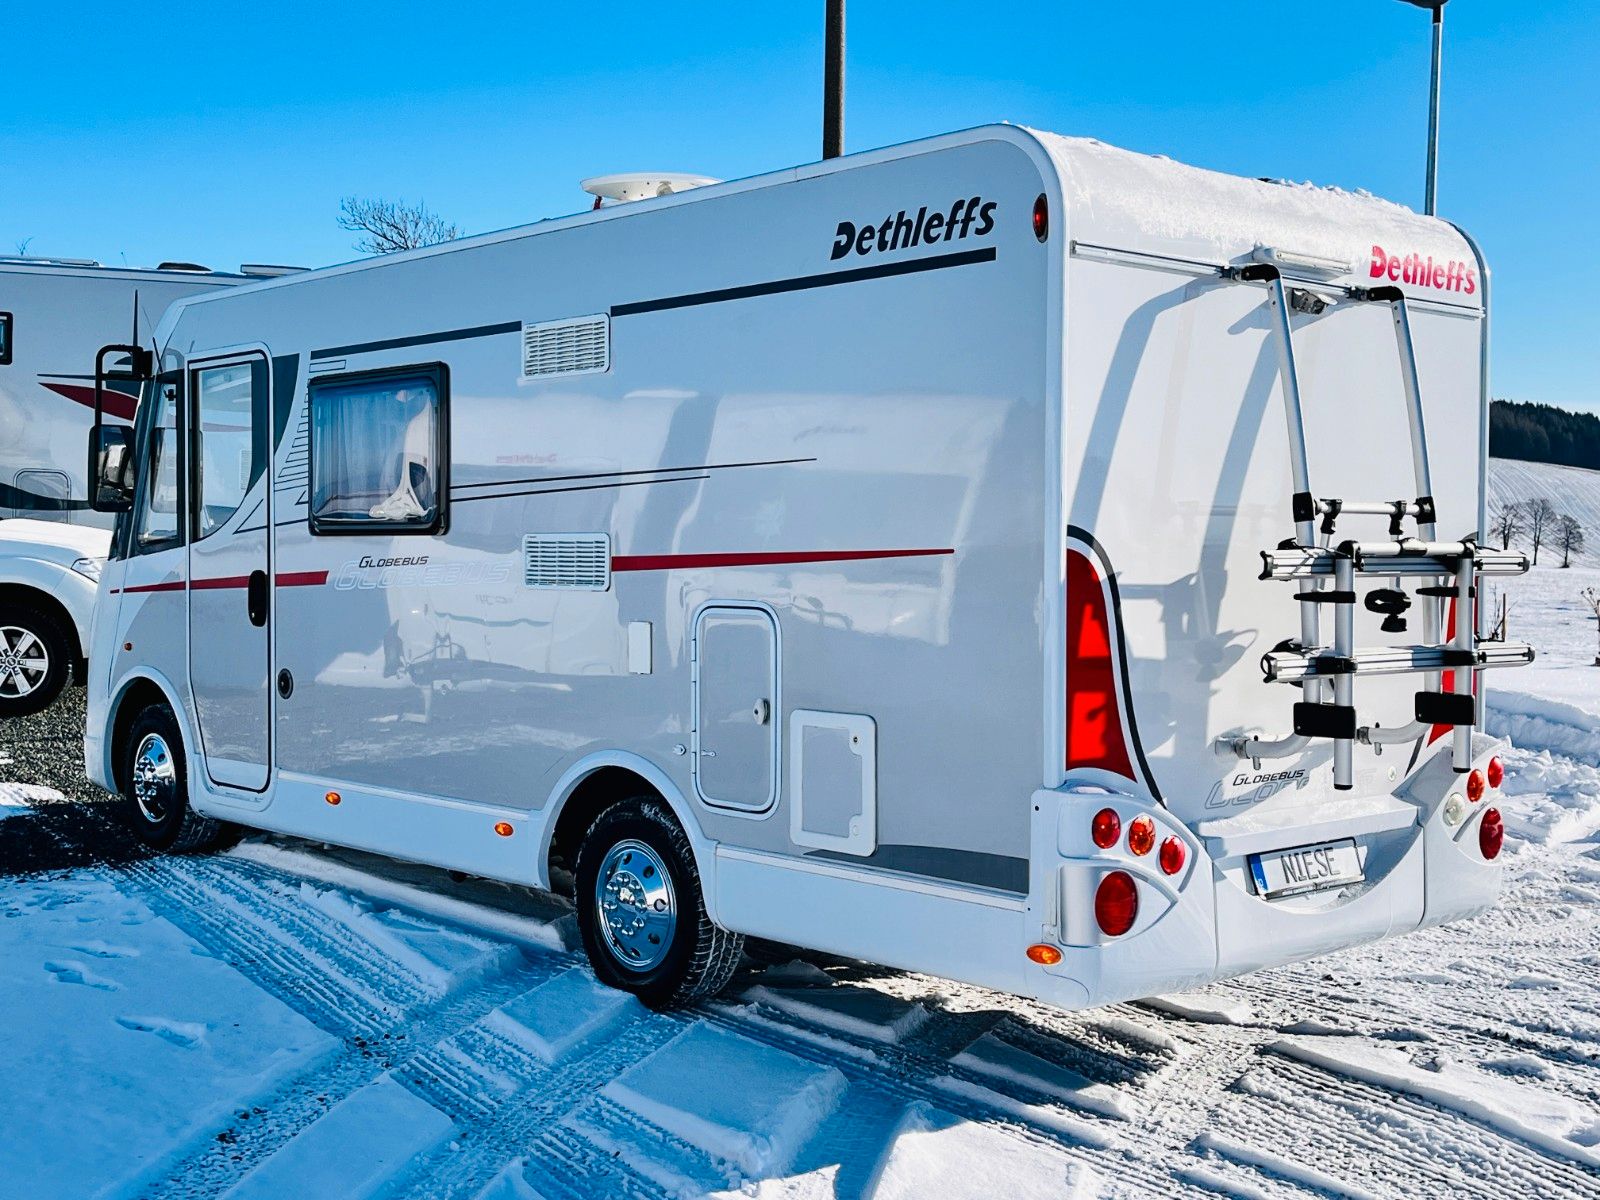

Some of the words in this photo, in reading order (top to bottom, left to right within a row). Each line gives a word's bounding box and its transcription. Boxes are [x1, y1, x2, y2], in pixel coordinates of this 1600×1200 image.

[830, 196, 997, 260] Dethleffs
[1369, 245, 1475, 295] Dethleffs
[358, 555, 429, 568] GLOBEBUS
[1232, 768, 1305, 786] GLOBEBUS
[1280, 846, 1340, 884] NIESE
